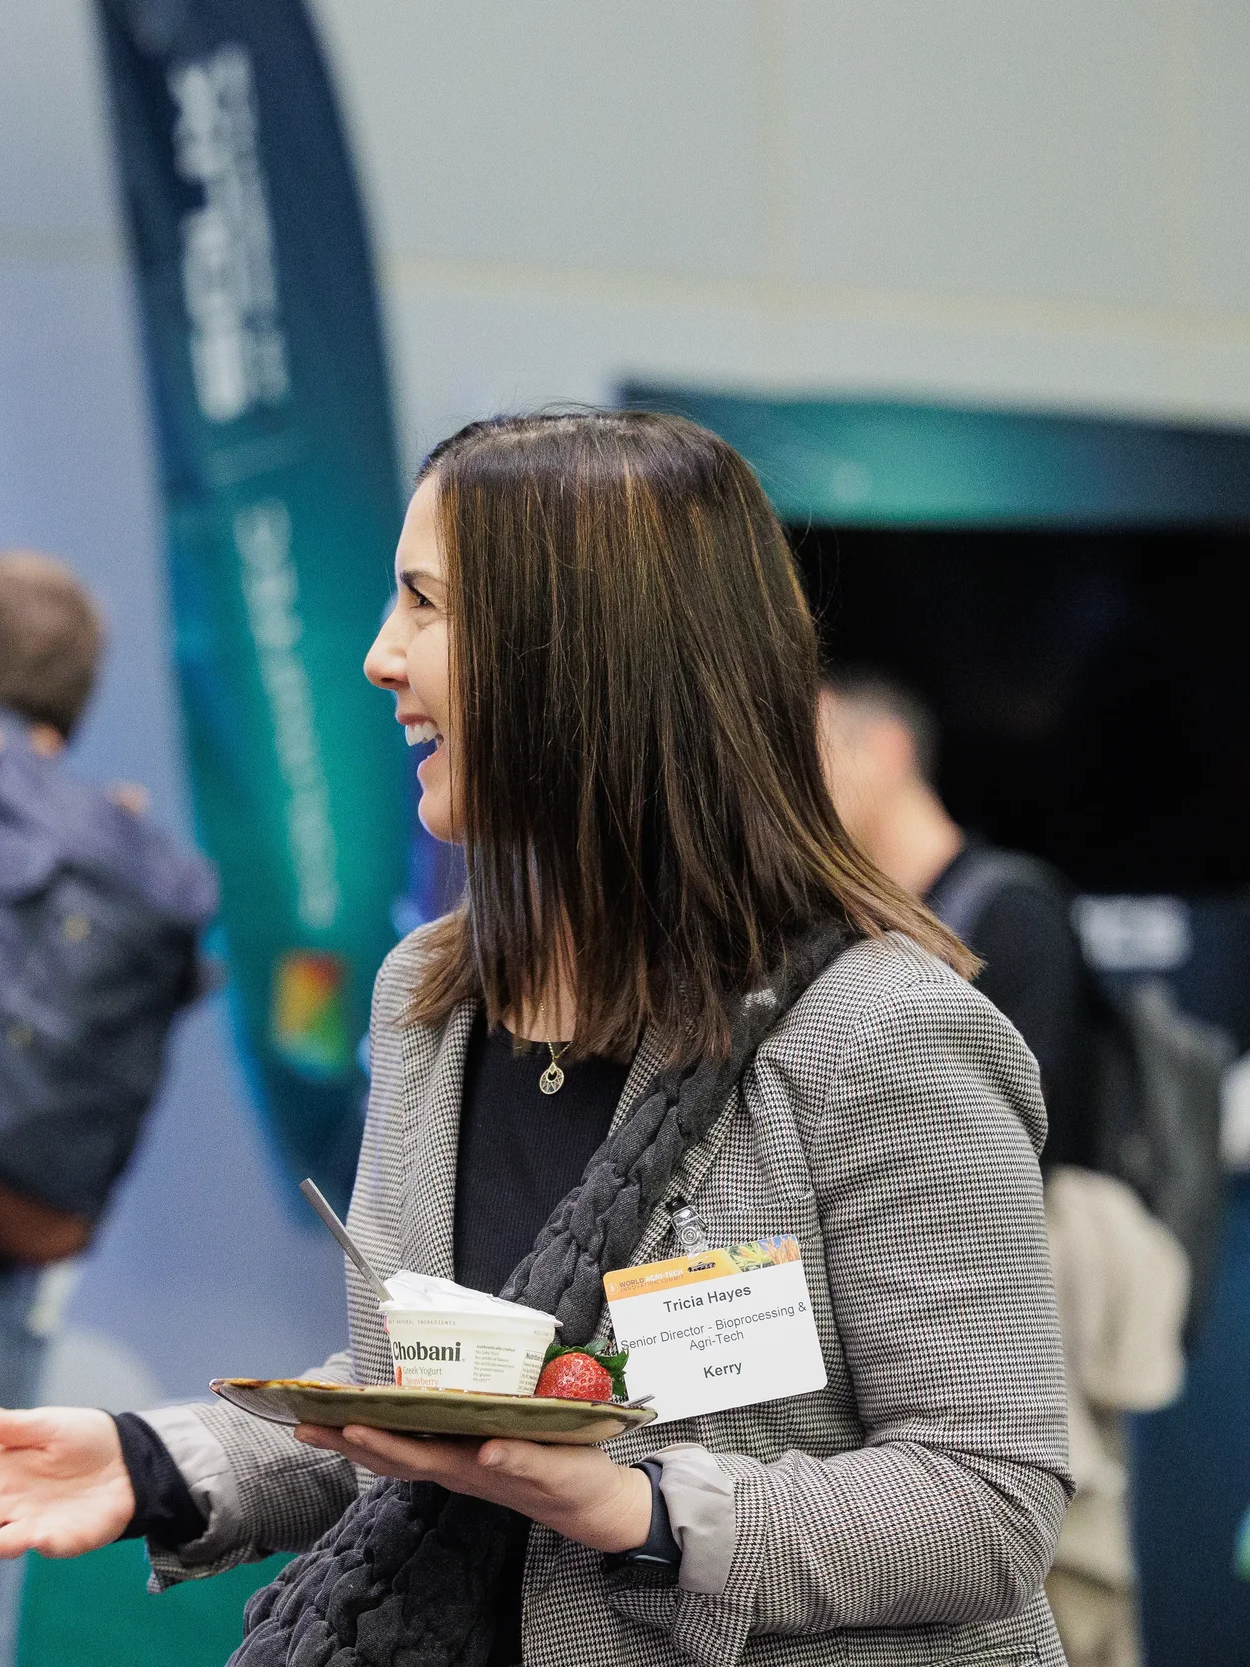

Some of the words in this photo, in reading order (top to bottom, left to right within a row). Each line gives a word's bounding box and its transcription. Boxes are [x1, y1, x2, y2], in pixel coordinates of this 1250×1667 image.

[619, 1278, 644, 1288] WORLD
[645, 1269, 683, 1282] AGRI-TECH
[620, 1281, 658, 1292] INNOVATION
[660, 1275, 684, 1284] SUMMIT
[663, 1296, 704, 1313] Tricia
[707, 1285, 752, 1304] Hayes
[620, 1336, 657, 1351] Senior
[660, 1324, 704, 1341] Director
[715, 1305, 795, 1331] Bioprocessing
[798, 1301, 807, 1312] &
[689, 1330, 744, 1351] Agri-Tech
[393, 1341, 461, 1362] Chobani
[403, 1366, 418, 1376] Greek
[420, 1367, 442, 1378] Yogurt
[703, 1361, 742, 1379] Kerry
[406, 1376, 438, 1387] Strawberry
